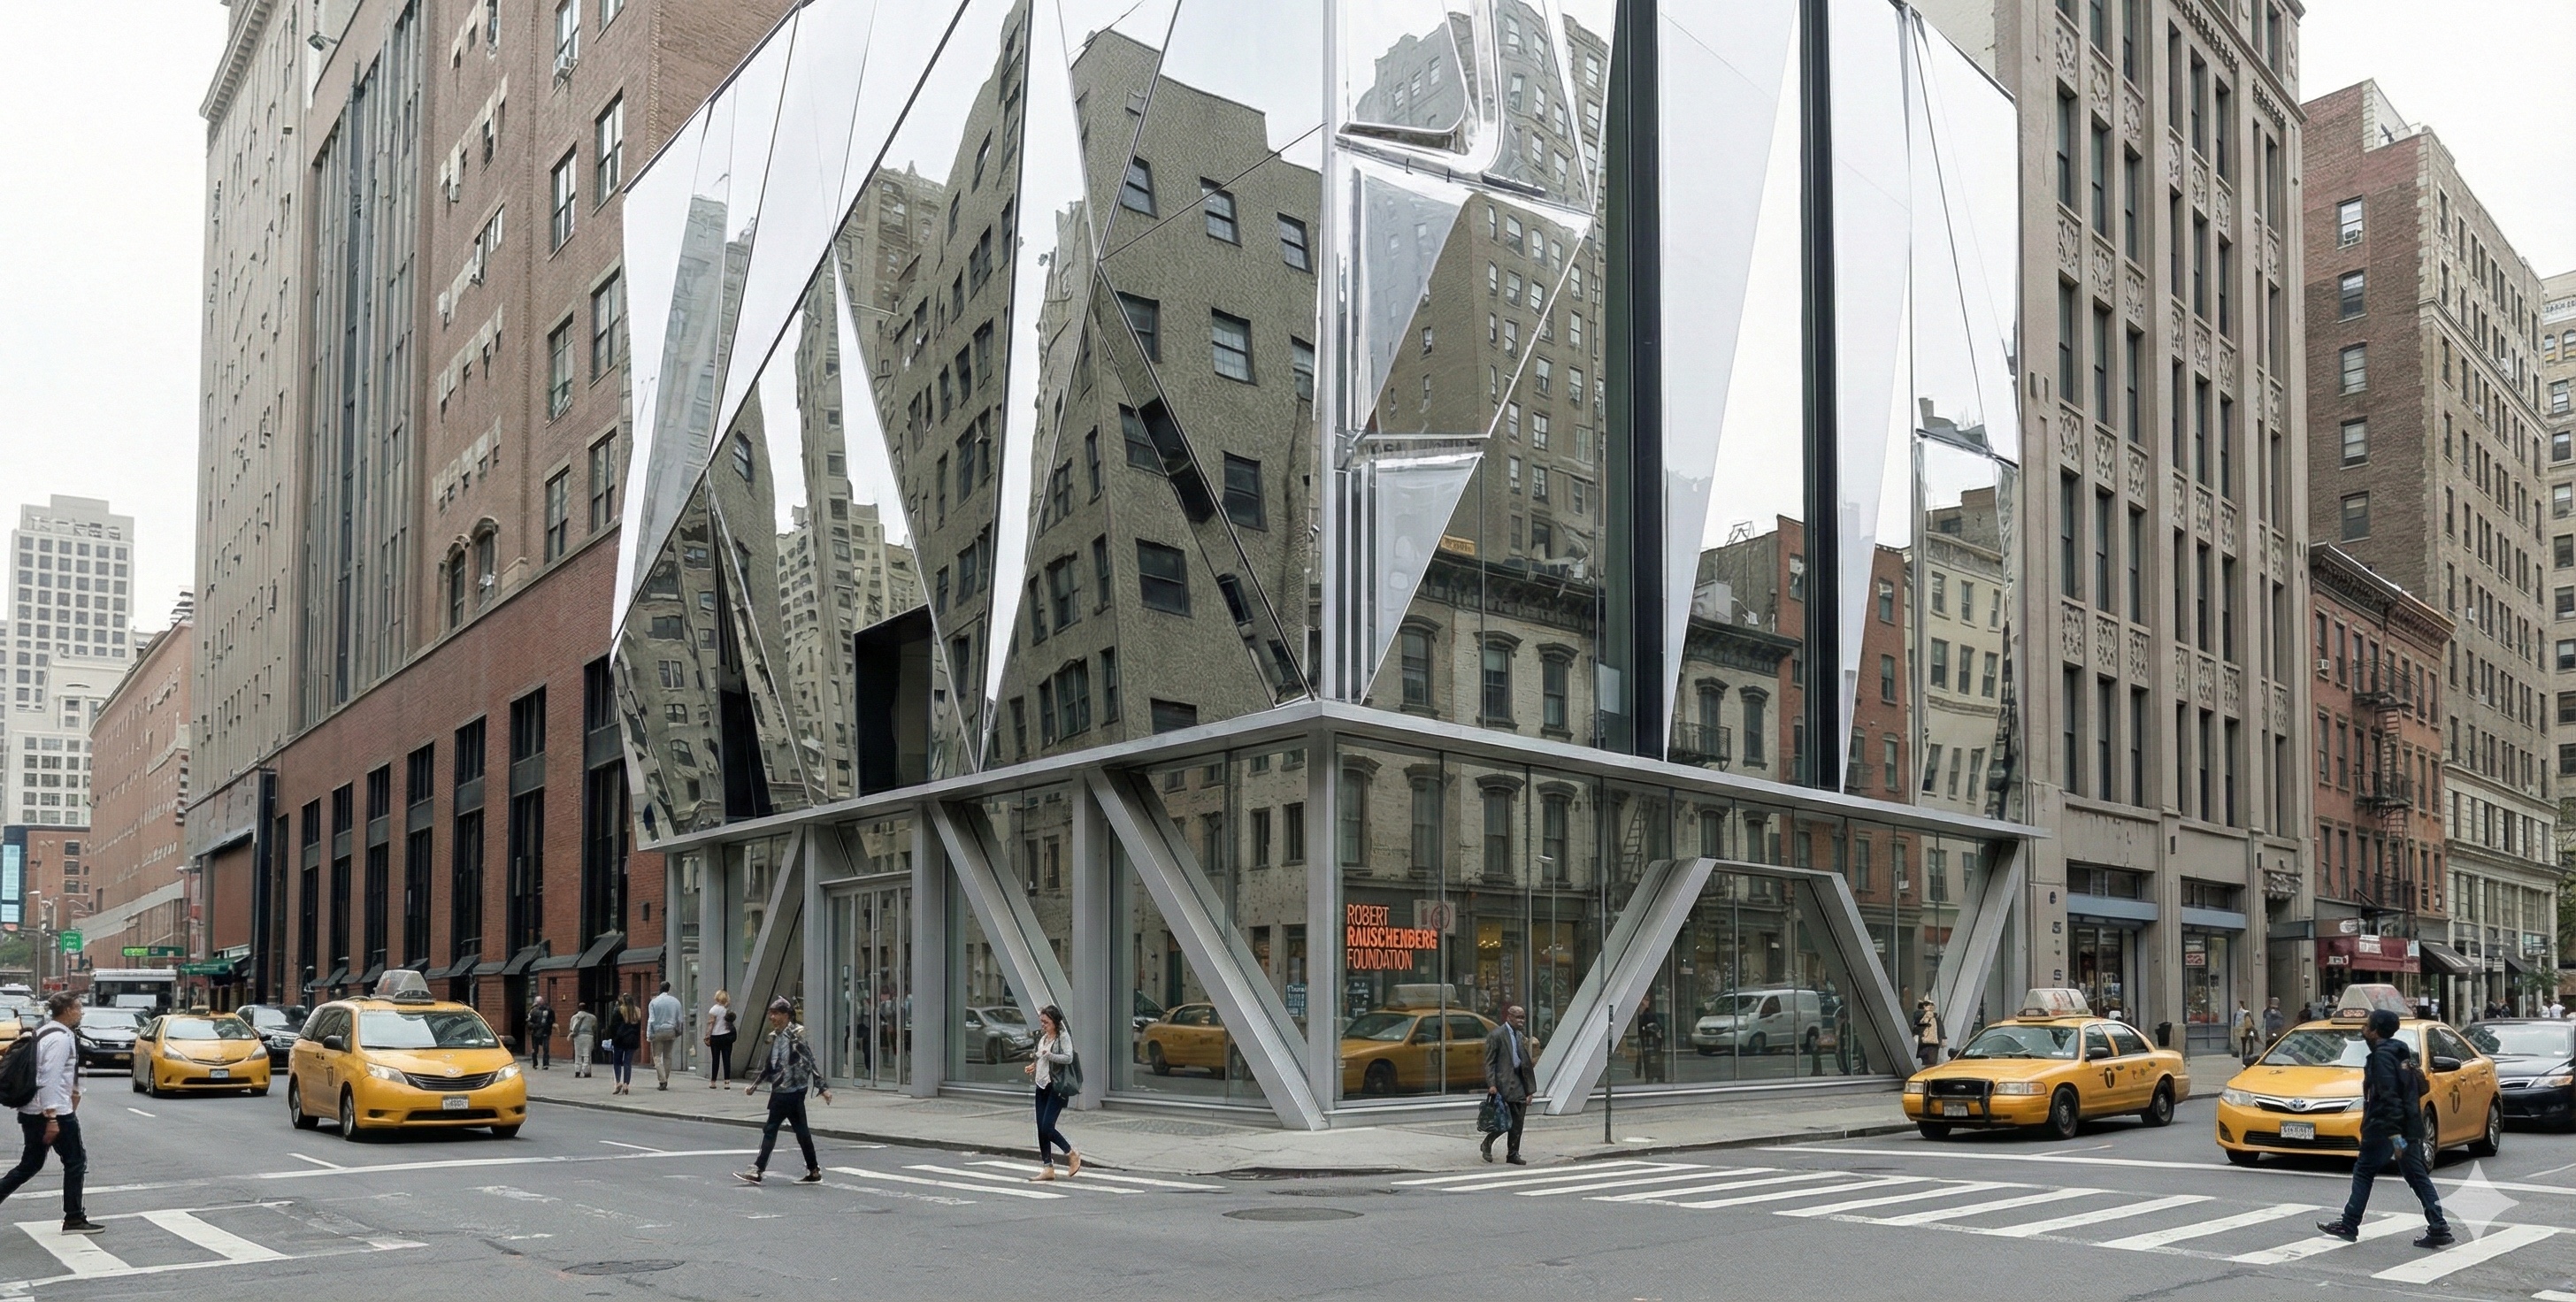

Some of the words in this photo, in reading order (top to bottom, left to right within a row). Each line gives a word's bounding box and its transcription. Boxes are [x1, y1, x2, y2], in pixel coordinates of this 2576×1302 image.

[1347, 904, 1389, 926] ROBERT
[1347, 926, 1438, 949] RAUSCHENBERG
[1347, 948, 1413, 970] FOUNDATION
